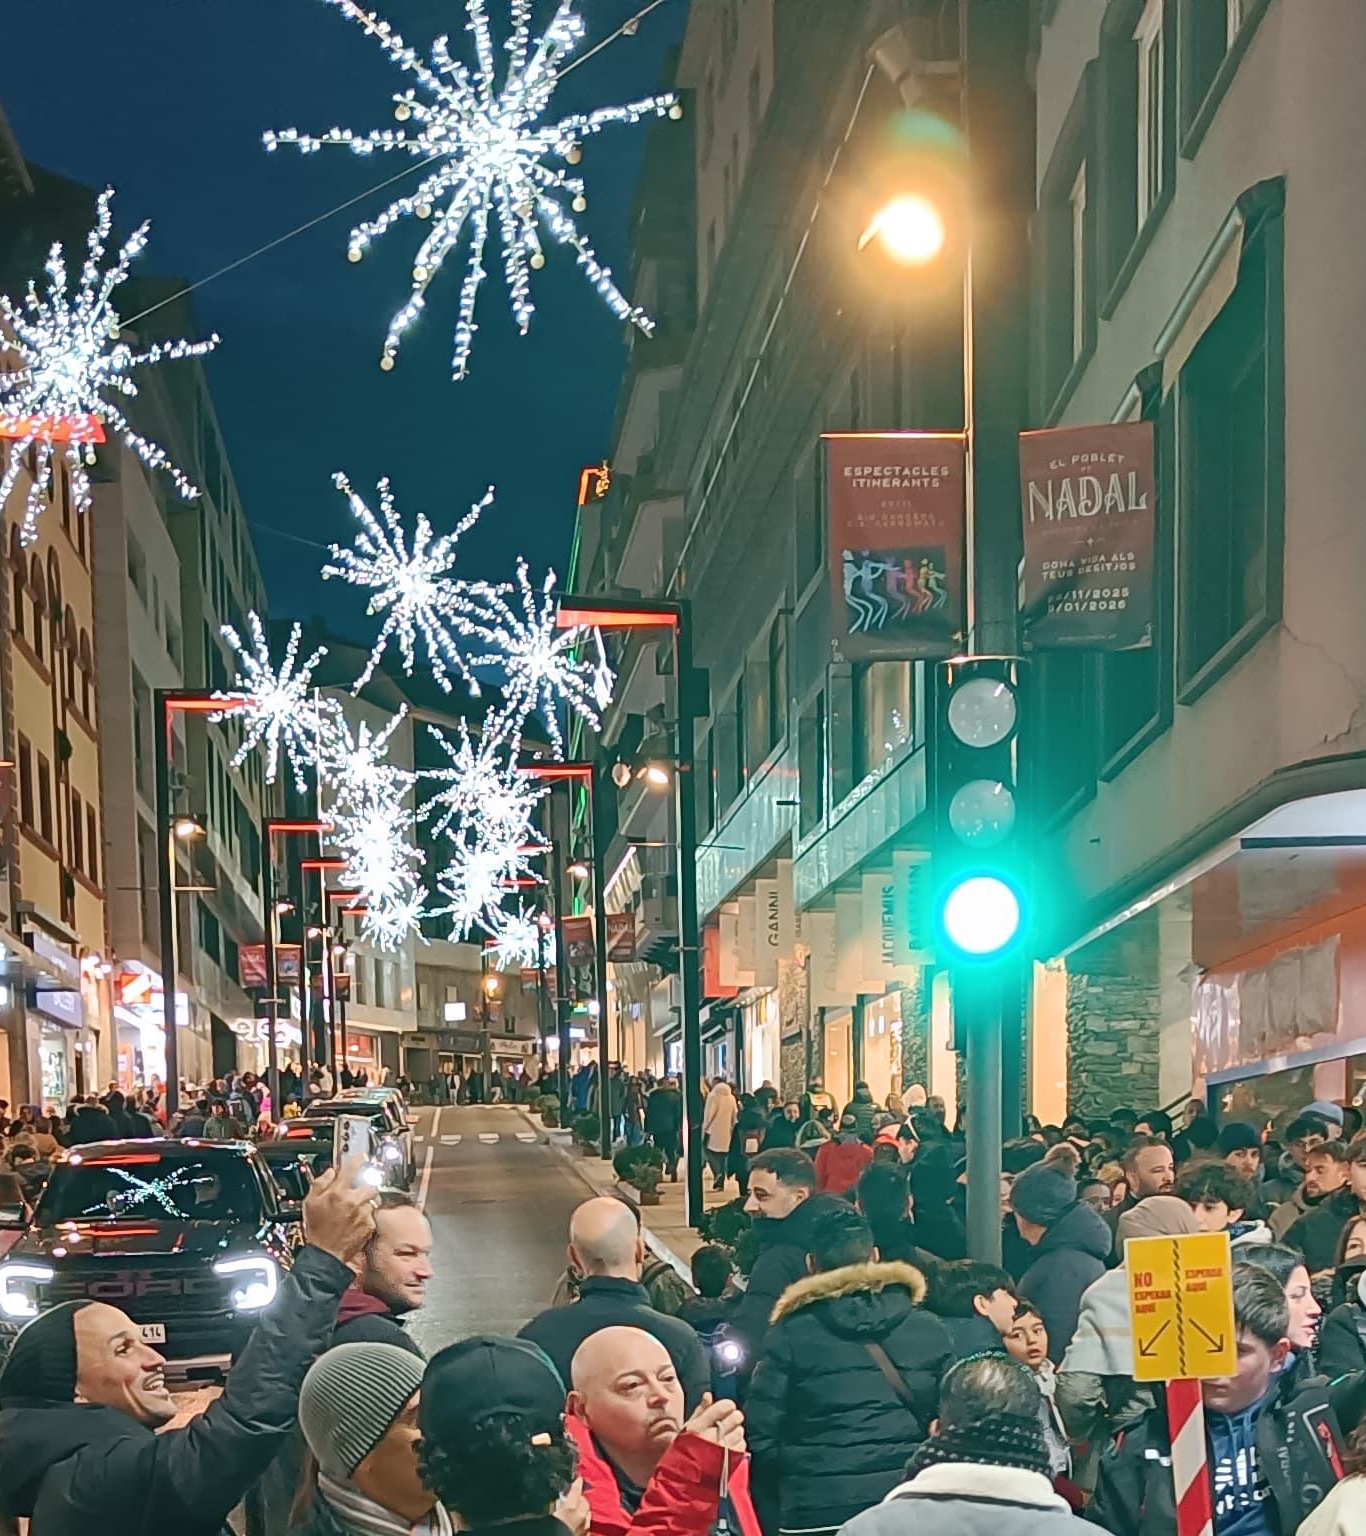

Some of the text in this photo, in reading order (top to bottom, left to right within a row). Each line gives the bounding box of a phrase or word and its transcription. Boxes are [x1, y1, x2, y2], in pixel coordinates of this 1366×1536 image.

[1050, 453, 1125, 469] EL POBLET
[843, 466, 950, 476] ESPECTACLES
[852, 478, 941, 488] ITINERANTS
[1028, 471, 1148, 523] NADAL
[1042, 560, 1076, 570] DONA
[1041, 570, 1073, 580] TEUS
[768, 891, 778, 946] GANNI
[1134, 1272, 1152, 1288] NO
